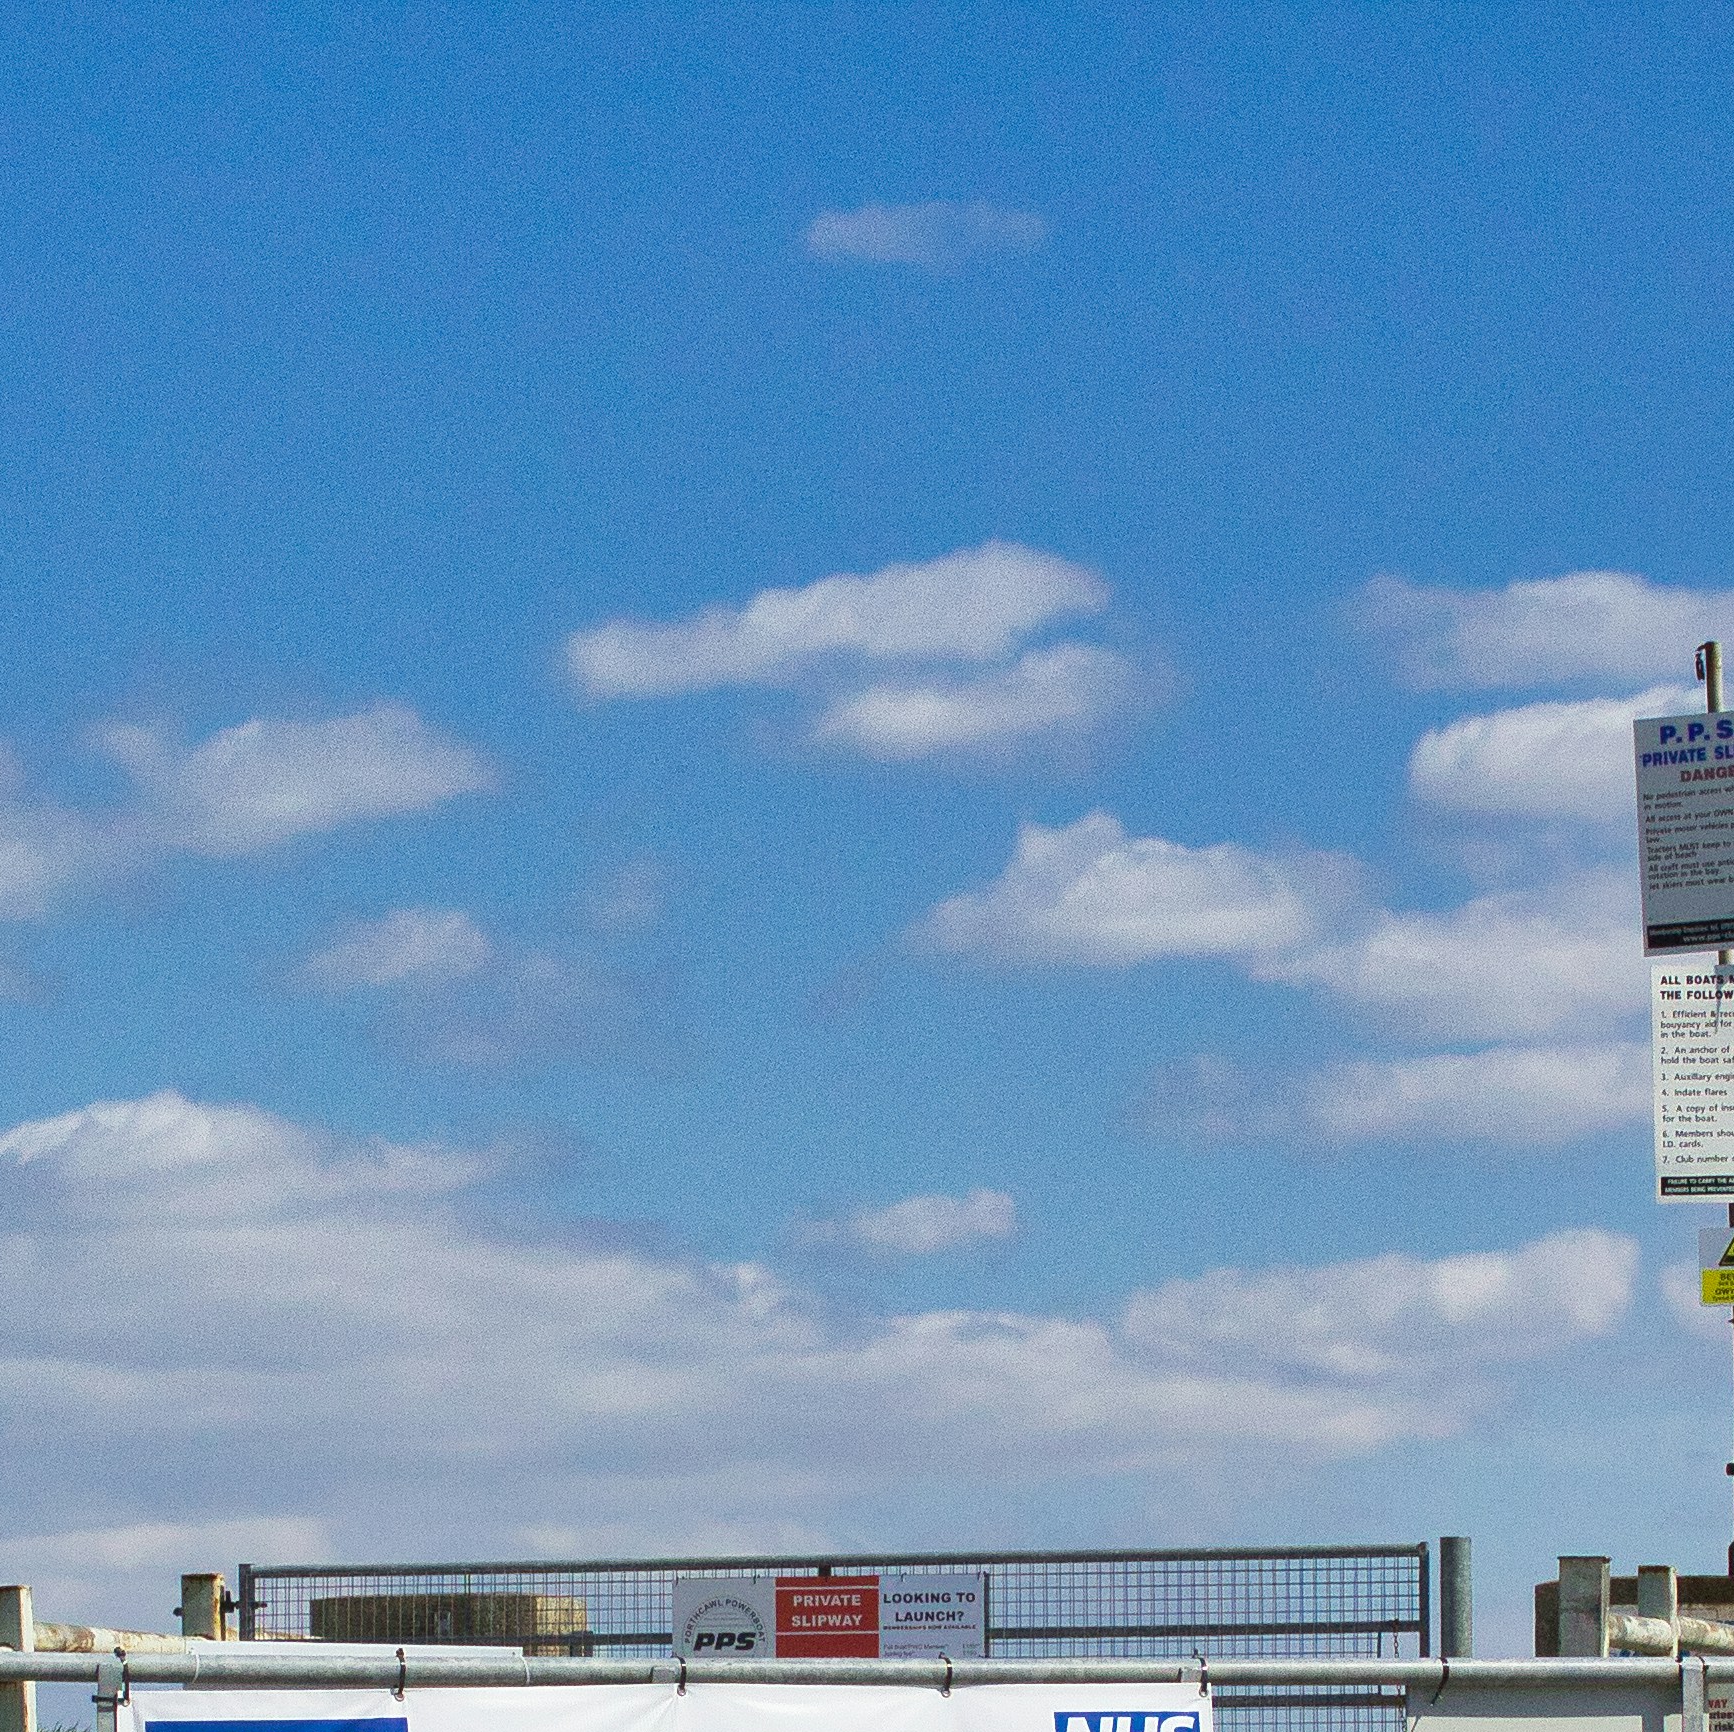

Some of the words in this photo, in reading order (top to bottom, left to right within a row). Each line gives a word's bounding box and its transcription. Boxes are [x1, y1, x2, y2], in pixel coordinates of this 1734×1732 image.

[1642, 747, 1706, 767] PRIVATE
[1695, 812, 1711, 820] your
[1660, 975, 1681, 985] ALL
[1687, 975, 1724, 984] BOATS
[1660, 991, 1681, 999] THE
[1689, 1030, 1711, 1038] boat.
[1709, 1104, 1718, 1112] of
[1695, 1114, 1717, 1122] boat.
[1697, 1154, 1728, 1162] number
[793, 1594, 861, 1607] PRIVATE
[883, 1592, 952, 1603] LOOKING
[956, 1592, 975, 1602] TO
[685, 1599, 723, 1644] PORTHCAWL
[726, 1599, 765, 1642] POWERBOAT
[791, 1614, 862, 1628] SLIPWAY
[895, 1611, 964, 1622] LAUNCH?
[693, 1632, 756, 1651] PPS
